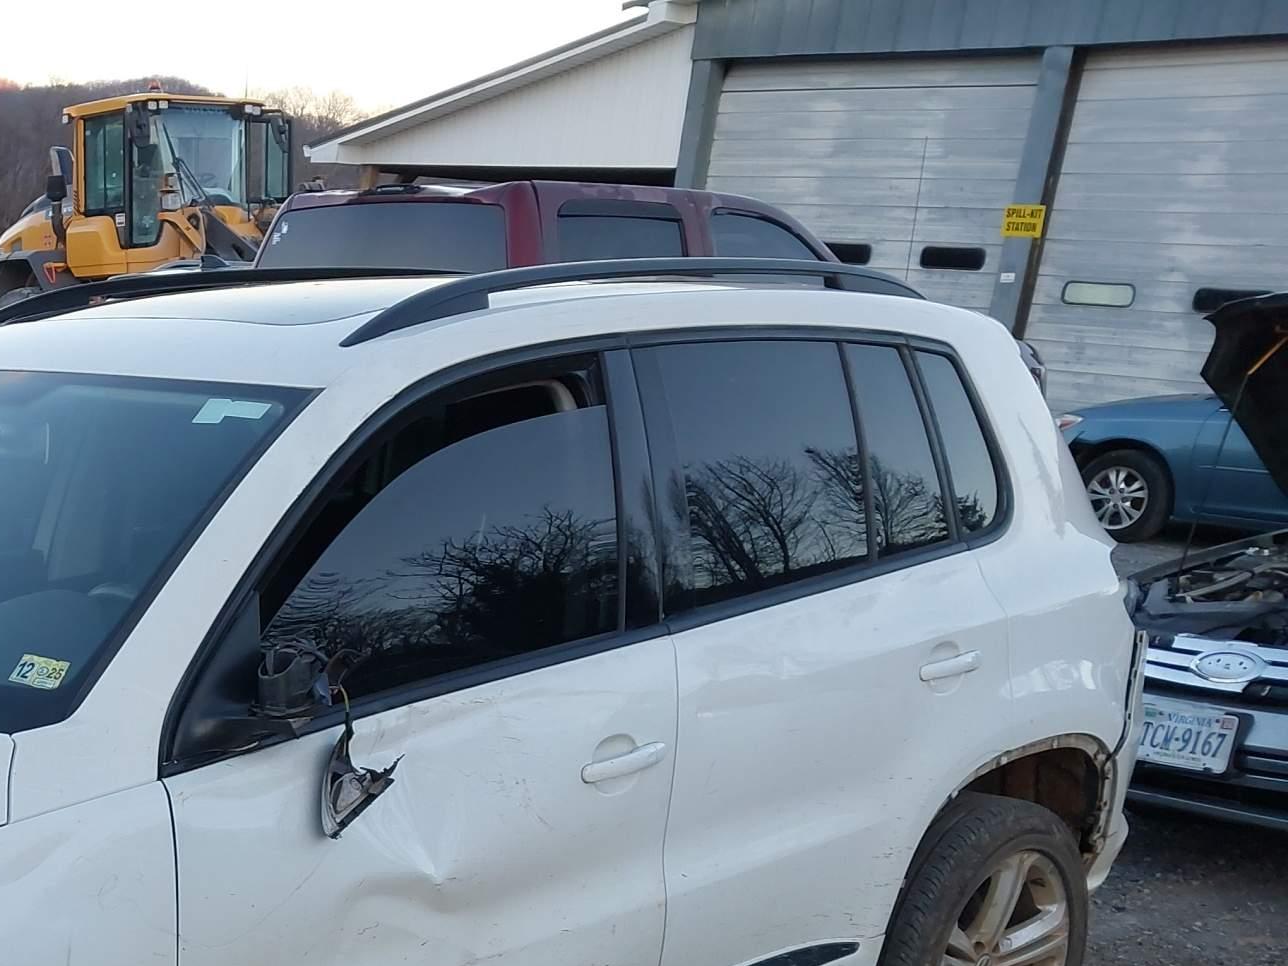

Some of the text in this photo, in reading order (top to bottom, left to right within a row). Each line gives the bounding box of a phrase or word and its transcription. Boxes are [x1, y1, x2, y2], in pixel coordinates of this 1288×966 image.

[1006, 207, 1043, 219] SPILL-KIT
[1006, 221, 1038, 232] STATION
[15, 661, 64, 680] 12 25
[1167, 712, 1212, 728] VIRGINIA
[1139, 721, 1228, 758] TCM-9167
